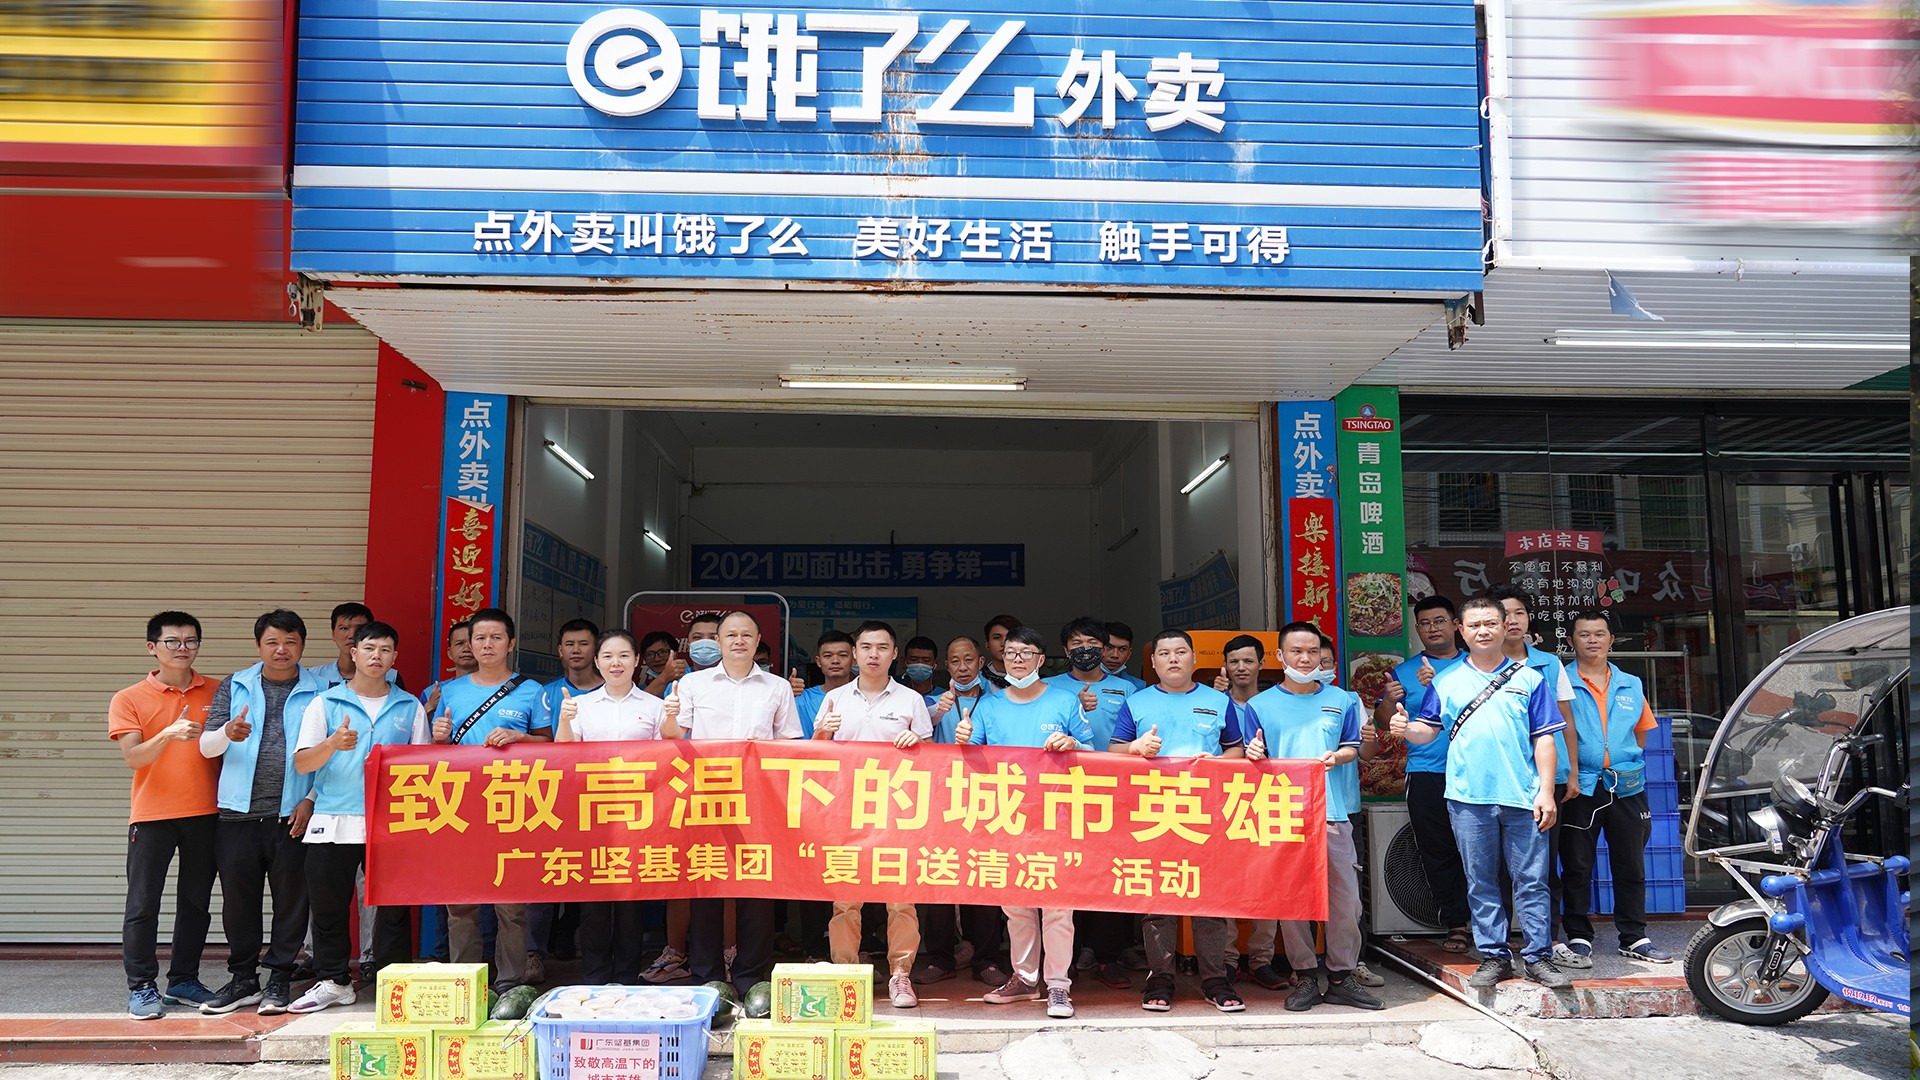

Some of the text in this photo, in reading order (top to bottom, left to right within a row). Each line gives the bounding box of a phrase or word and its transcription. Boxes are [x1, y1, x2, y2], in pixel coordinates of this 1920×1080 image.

[473, 210, 1291, 265] 点外卖叫饿了么 美好生活 触手可得
[1345, 420, 1391, 430] TSINGTAO
[1358, 442, 1384, 556] 青岛啤酒
[1517, 533, 1590, 551] 本店宗旨
[448, 508, 488, 628] 喜迎好
[1509, 561, 1603, 573] 不便宜 不暴利
[1522, 578, 1594, 590] 没有地沟油
[388, 756, 1305, 847] 致敬高温下的城市英雄
[596, 1038, 650, 1047] 广东坚基集团
[574, 1057, 655, 1070] 致敬高温下的
